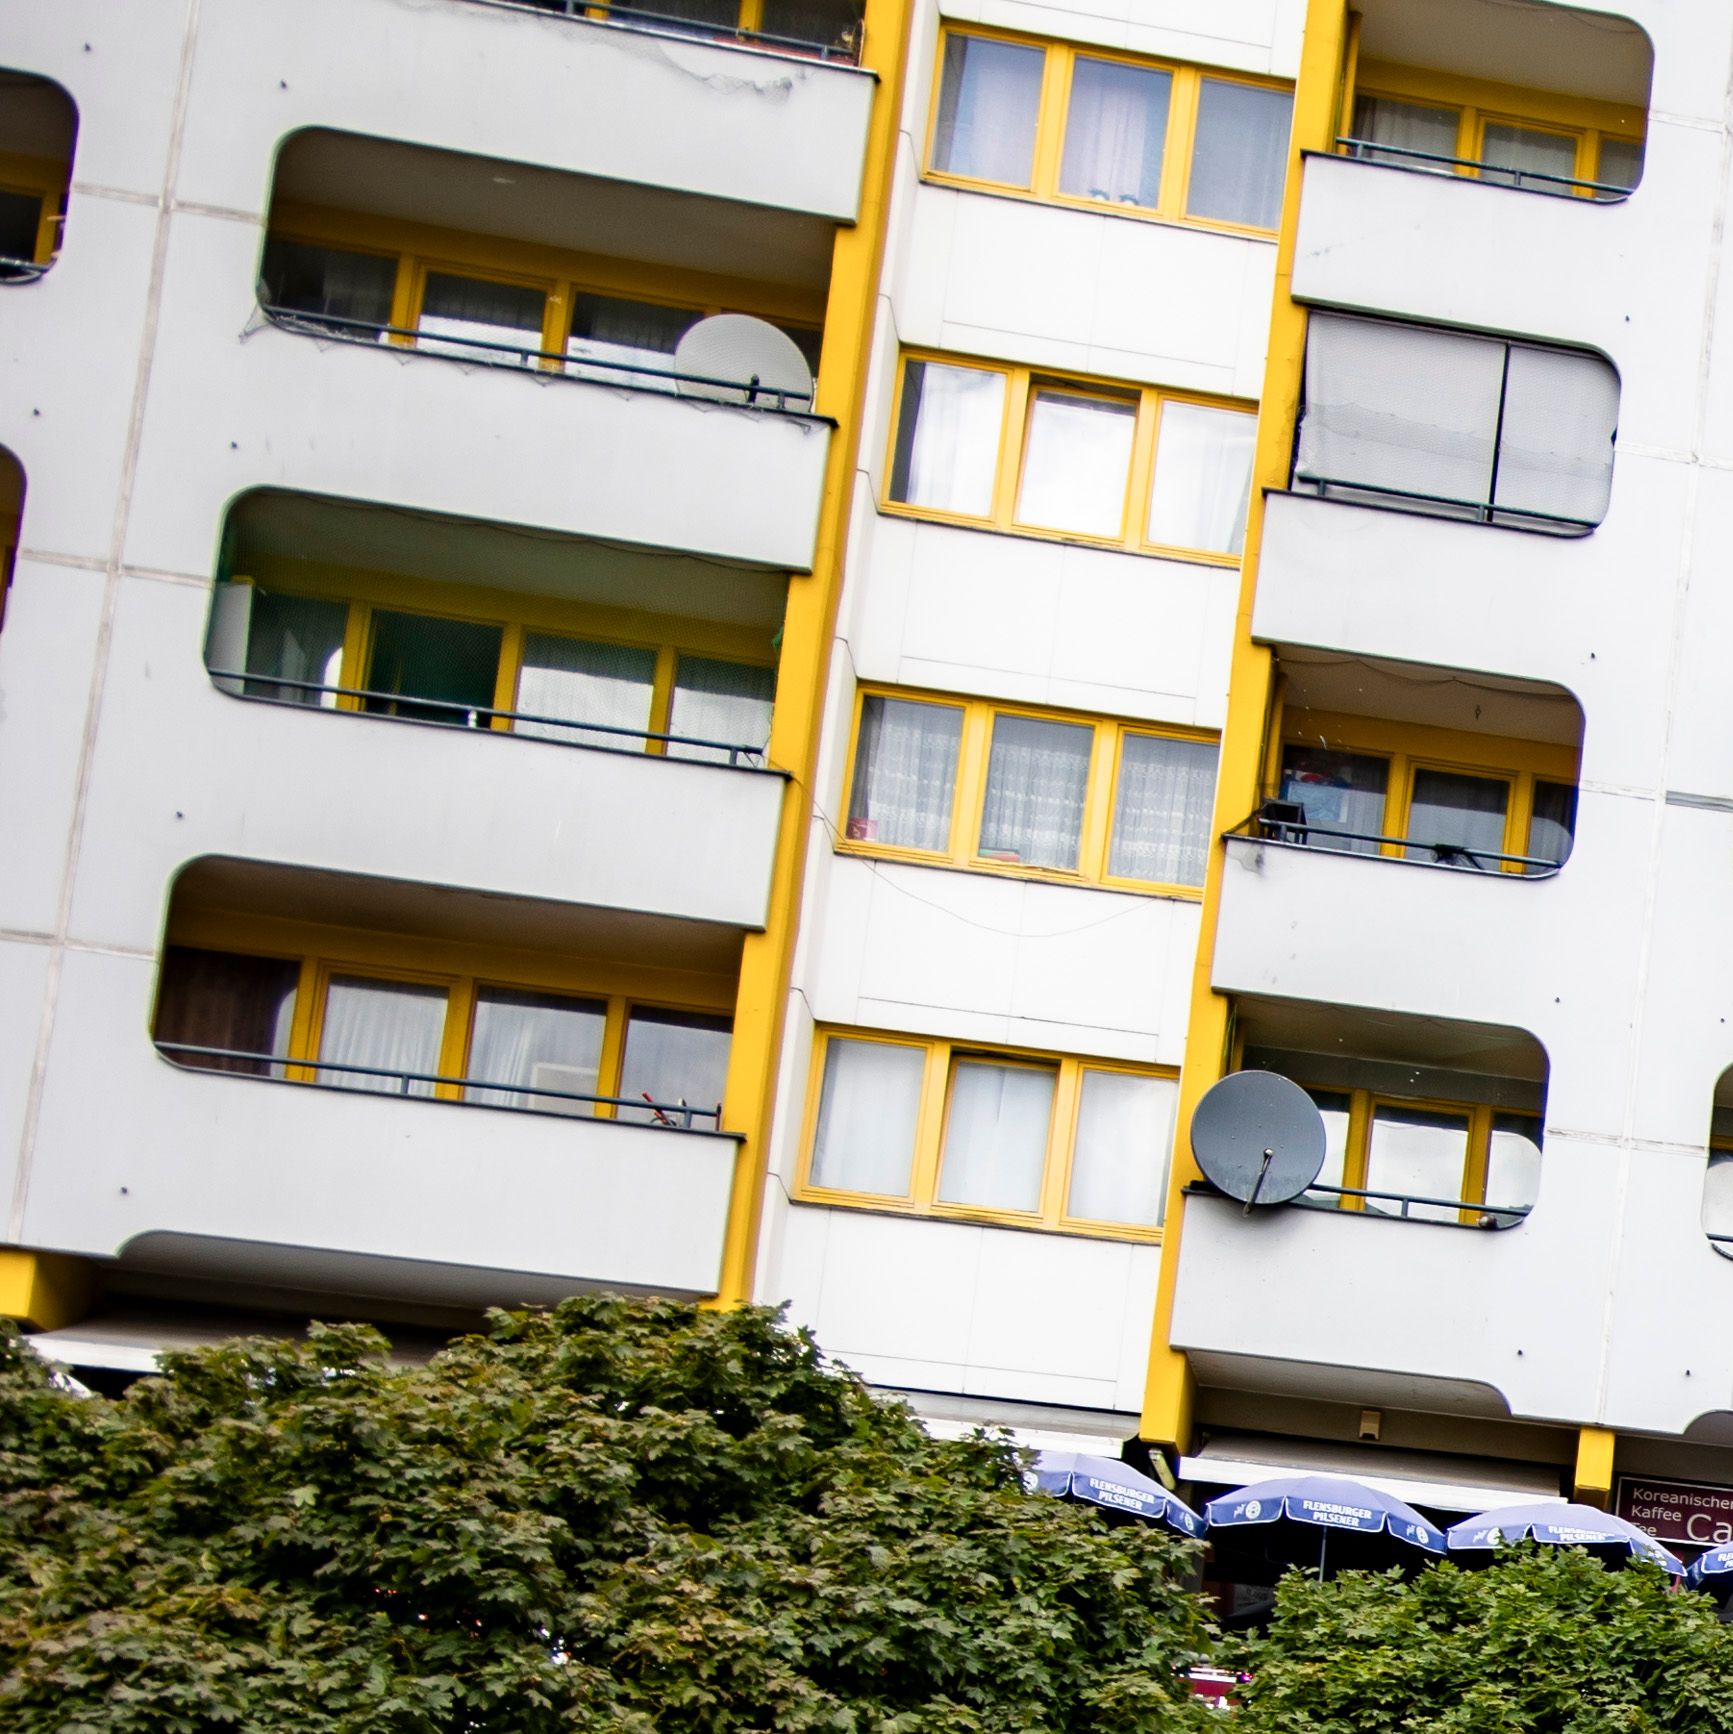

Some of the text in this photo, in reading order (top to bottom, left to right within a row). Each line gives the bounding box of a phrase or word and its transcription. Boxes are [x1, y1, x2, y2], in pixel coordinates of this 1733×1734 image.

[1090, 1477, 1155, 1504] FLENSBURGER
[1098, 1491, 1144, 1511] PILSENER
[1303, 1500, 1372, 1519] FLENSBURGER
[1313, 1511, 1360, 1527] PILSENER
[1631, 1505, 1682, 1522] Kaffee
